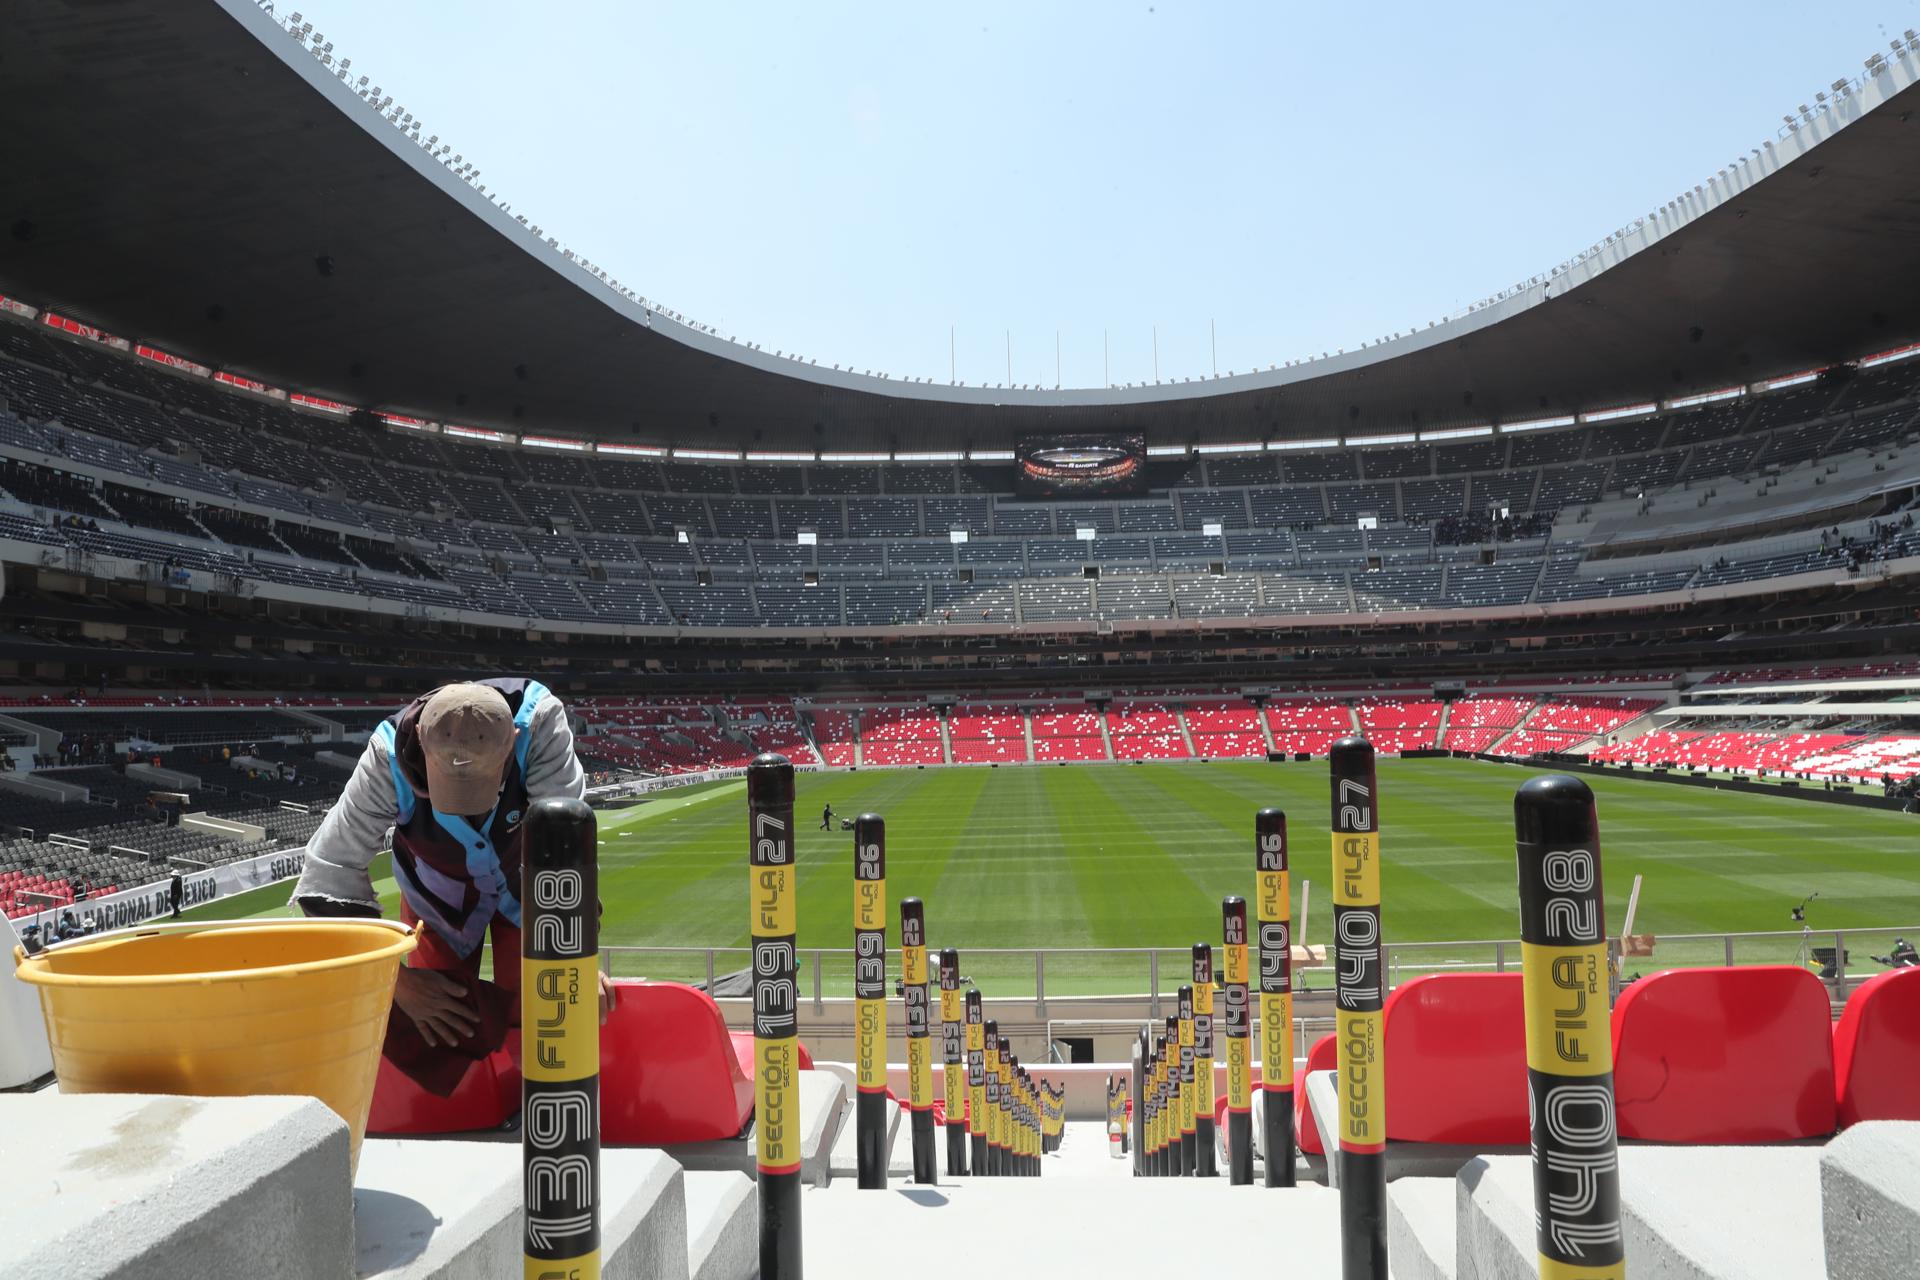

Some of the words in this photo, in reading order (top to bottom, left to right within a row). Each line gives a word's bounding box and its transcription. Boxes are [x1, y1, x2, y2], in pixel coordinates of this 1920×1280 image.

[1339, 778, 1371, 831] 27
[756, 813, 786, 863] 27
[1261, 833, 1283, 870] 26
[859, 843, 880, 879] 26
[1343, 838, 1362, 899] FILA
[180, 877, 217, 908] ÉXICO
[534, 869, 582, 954] 28
[760, 870, 778, 930] FILA
[861, 884, 874, 925] FILA
[1264, 874, 1277, 917] FILA
[1542, 849, 1598, 941] 28
[903, 918, 920, 946] 25
[1225, 916, 1243, 944] 25
[857, 932, 883, 997] 139
[905, 949, 915, 980] FILA
[1195, 959, 1209, 983] 24
[1228, 947, 1239, 979] FILA
[1260, 923, 1288, 992] 140
[1338, 910, 1379, 1008] 140
[1588, 954, 1598, 995] ROW
[569, 967, 579, 1005] ROW
[755, 941, 794, 1035] 139
[941, 967, 955, 990] 24
[1196, 985, 1204, 1011] FILA
[537, 968, 566, 1069] FILA
[905, 986, 926, 1036] 139
[943, 992, 951, 1018] FILA
[969, 1005, 980, 1024] 23
[1180, 1000, 1192, 1019] 23
[1226, 984, 1248, 1037] 140
[1552, 955, 1589, 1062] FILA
[860, 1003, 873, 1083] SECCIÓN
[942, 1022, 960, 1064] 139
[986, 1034, 997, 1050] 22
[1167, 1027, 1177, 1044] 22
[1194, 1015, 1211, 1057] 140
[1267, 998, 1282, 1081] SECCIÓN
[1367, 1018, 1375, 1063] SECTION
[969, 1050, 984, 1086] 139
[1167, 1067, 1179, 1097] 140
[1180, 1046, 1194, 1082] 140
[1345, 1018, 1368, 1137] SECCIÓN
[763, 1045, 784, 1160] SECCIÓN
[986, 1072, 999, 1101] 139
[1000, 1084, 1011, 1110] 139
[1158, 1082, 1168, 1109] 140
[527, 1090, 592, 1250] 139
[1544, 1085, 1620, 1258] 140
